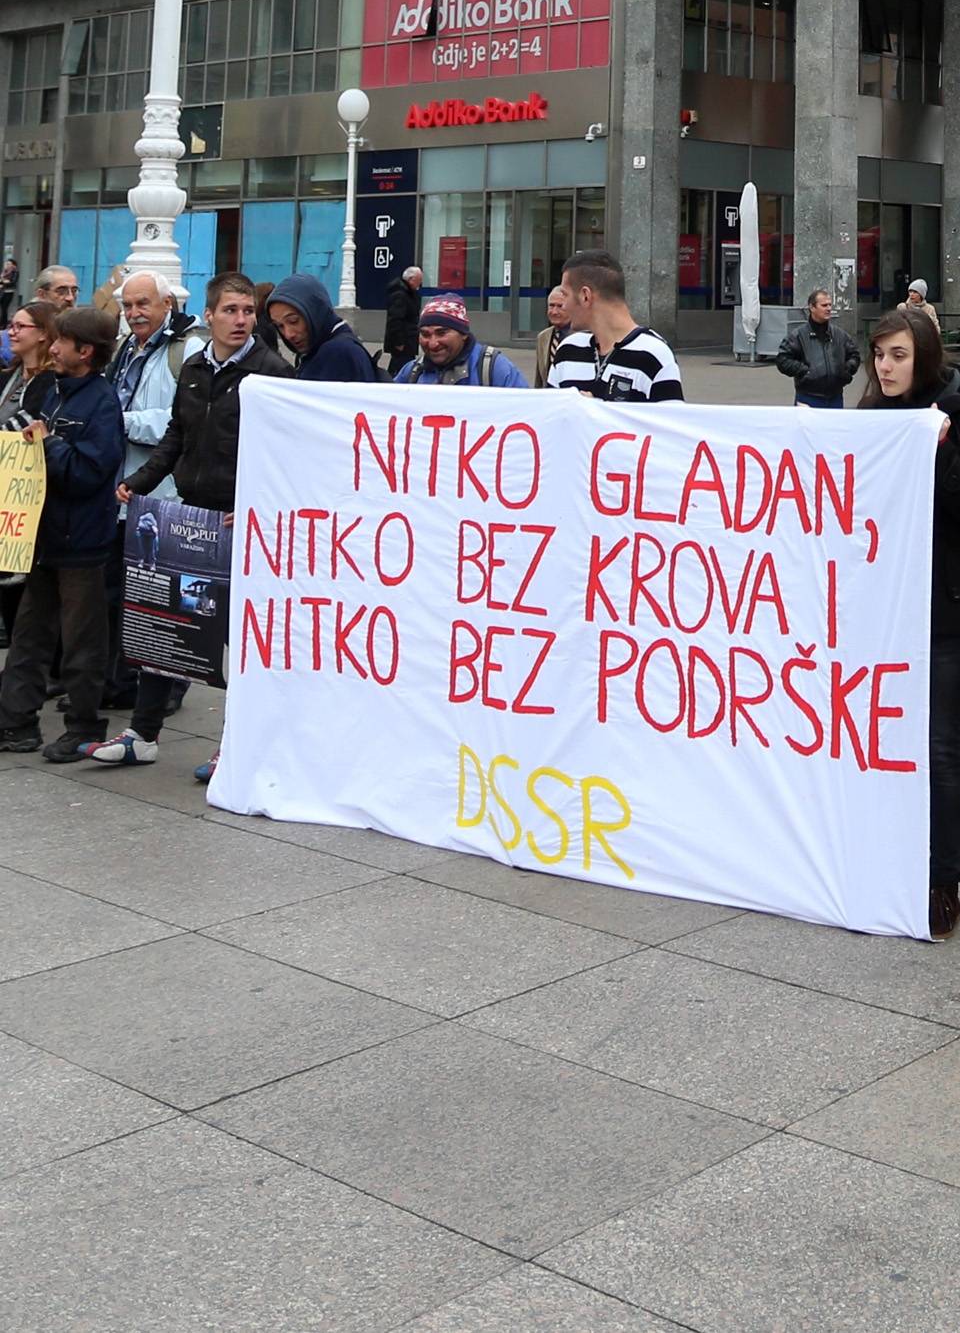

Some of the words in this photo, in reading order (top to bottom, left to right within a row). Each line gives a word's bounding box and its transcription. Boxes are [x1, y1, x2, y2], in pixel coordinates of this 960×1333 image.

[404, 97, 484, 128] Addiko
[484, 90, 548, 124] Bank
[432, 41, 468, 70] Gdje
[470, 45, 486, 69] je
[490, 36, 541, 61] 2+2=4
[170, 524, 191, 538] NOVI
[200, 530, 218, 543] PUT
[354, 413, 540, 510] NITKO
[591, 433, 879, 563] GLADAN,
[243, 509, 414, 586] NITKO
[458, 521, 556, 616] BEZ
[585, 533, 790, 636] KROVA
[827, 561, 838, 649] I
[242, 598, 399, 686] NITKO
[449, 620, 556, 715] BEZ
[598, 630, 917, 772] PODRŠKE
[456, 745, 635, 880] DSSR
